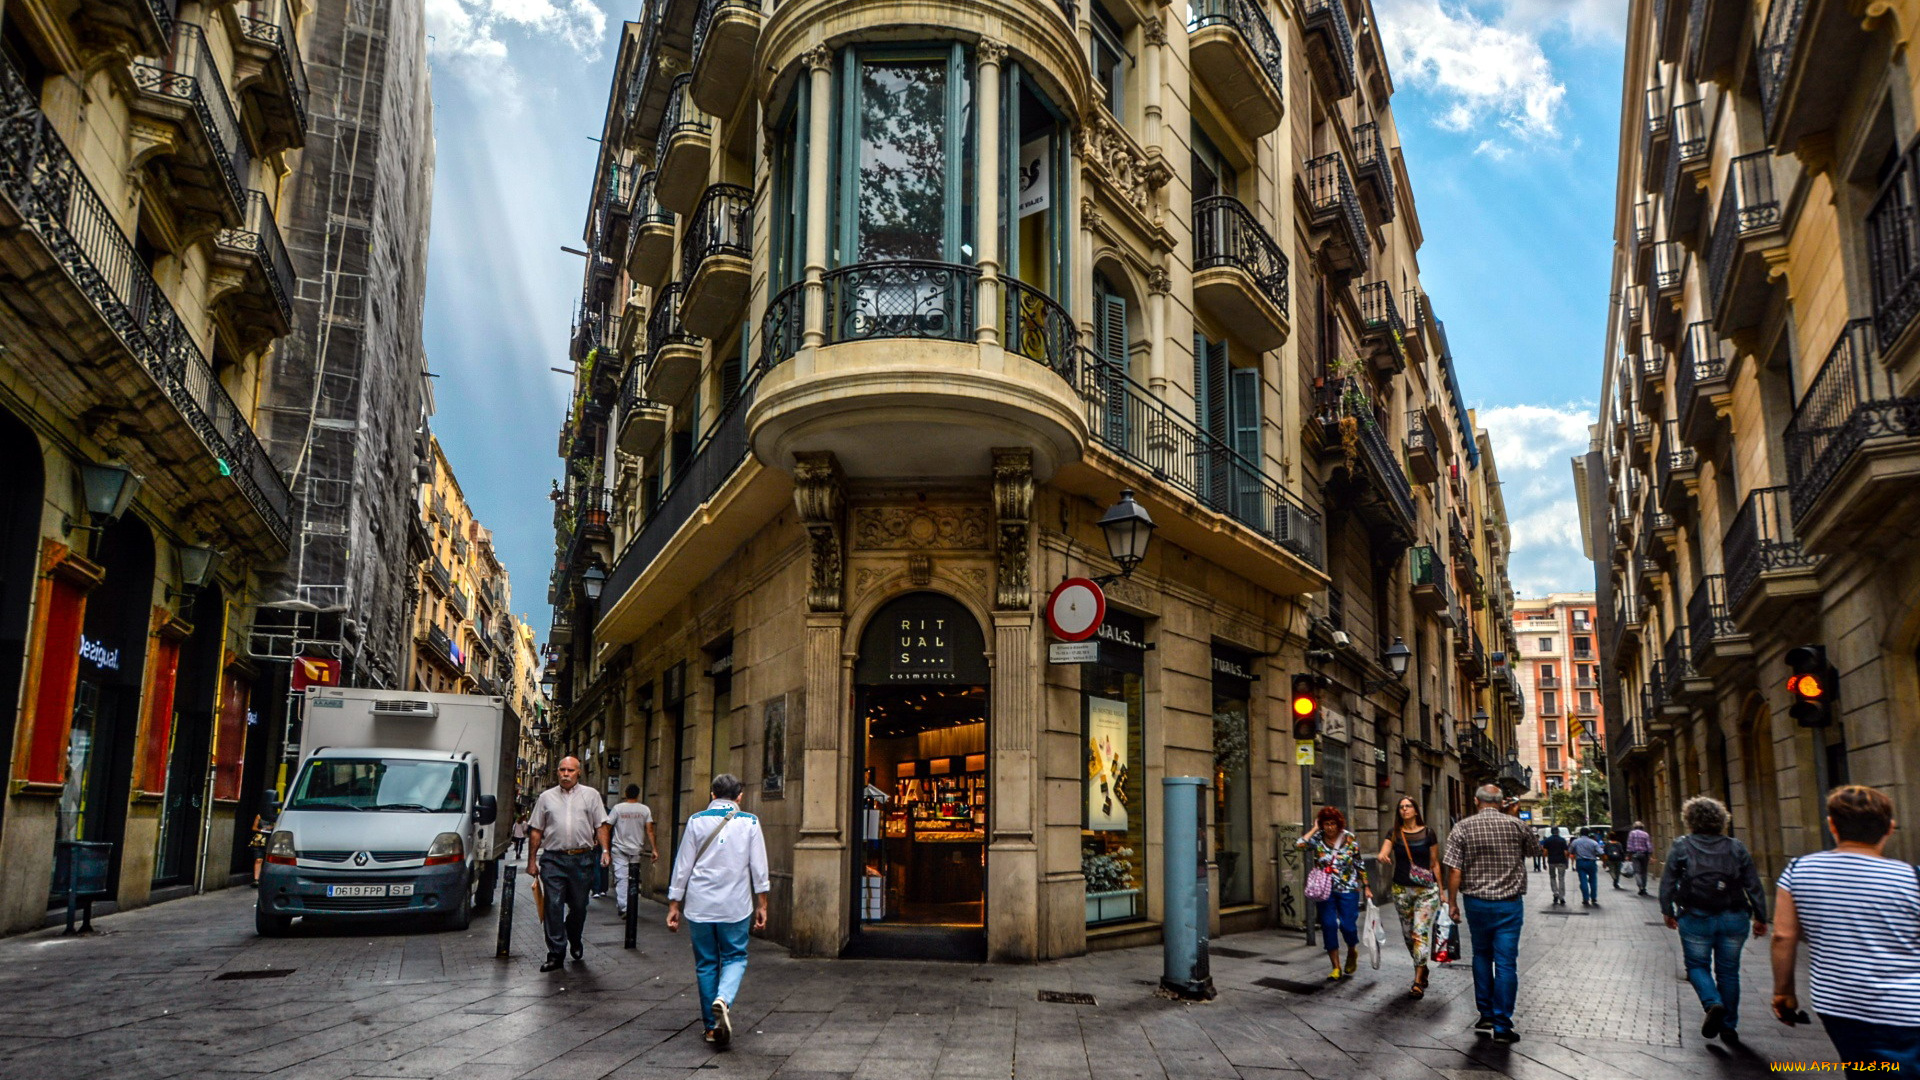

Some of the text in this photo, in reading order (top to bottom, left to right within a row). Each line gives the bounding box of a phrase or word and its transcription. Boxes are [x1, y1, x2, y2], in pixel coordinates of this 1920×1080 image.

[1025, 196, 1043, 207] VIAJES
[901, 620, 944, 630] RIT
[901, 636, 944, 647] UAL
[890, 672, 956, 680] cosmetics
[335, 886, 361, 896] 0619
[363, 886, 383, 896] FPP
